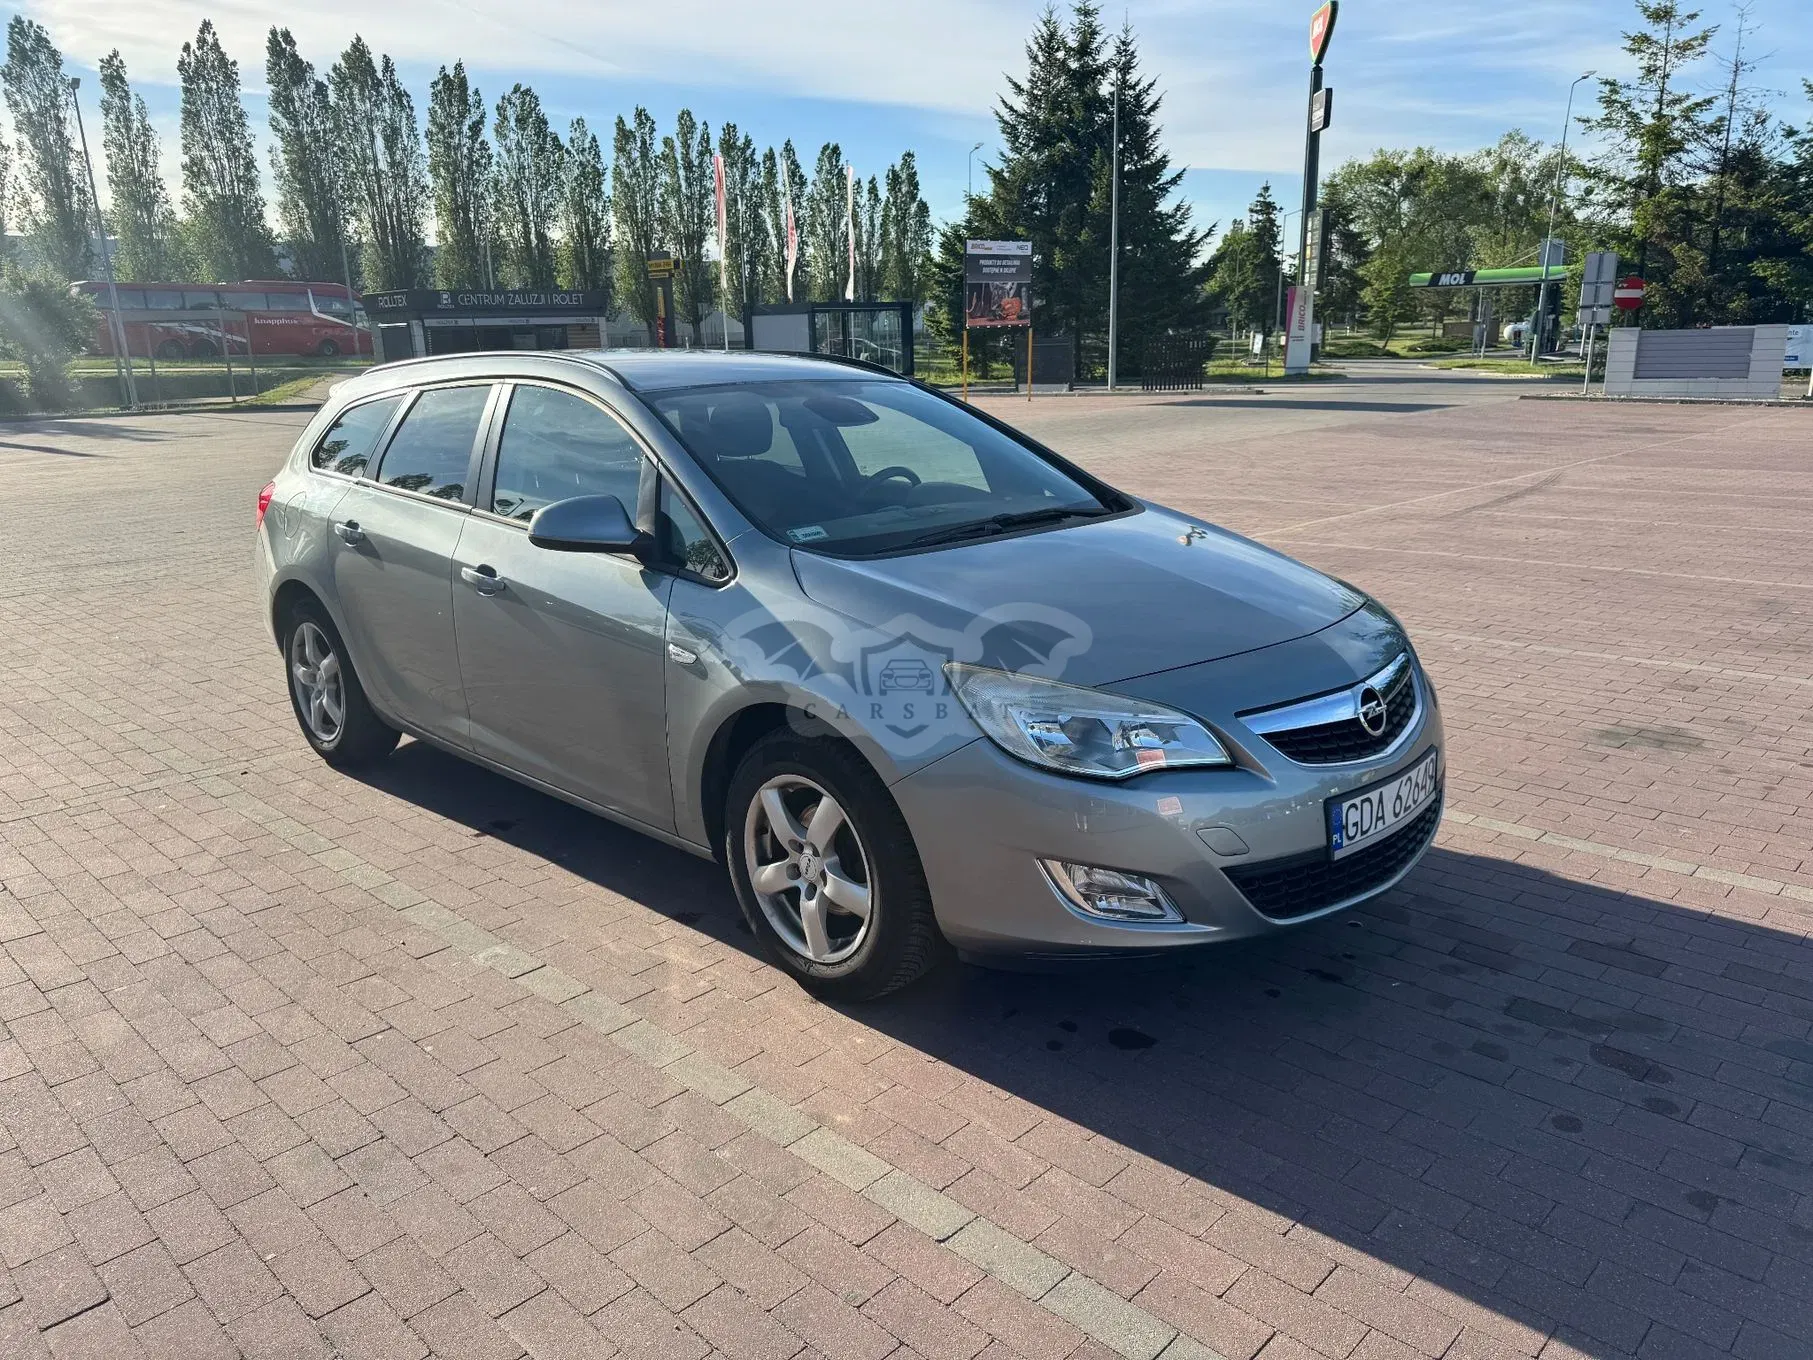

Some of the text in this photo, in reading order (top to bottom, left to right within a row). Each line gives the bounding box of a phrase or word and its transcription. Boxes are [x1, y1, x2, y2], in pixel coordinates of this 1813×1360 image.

[1438, 273, 1466, 286] MOL
[458, 293, 505, 306] CENTRUM
[552, 293, 584, 305] ROLET
[1298, 305, 1306, 331] BRICO
[1345, 757, 1435, 841] GDA 62649
[1332, 833, 1342, 845] PL
